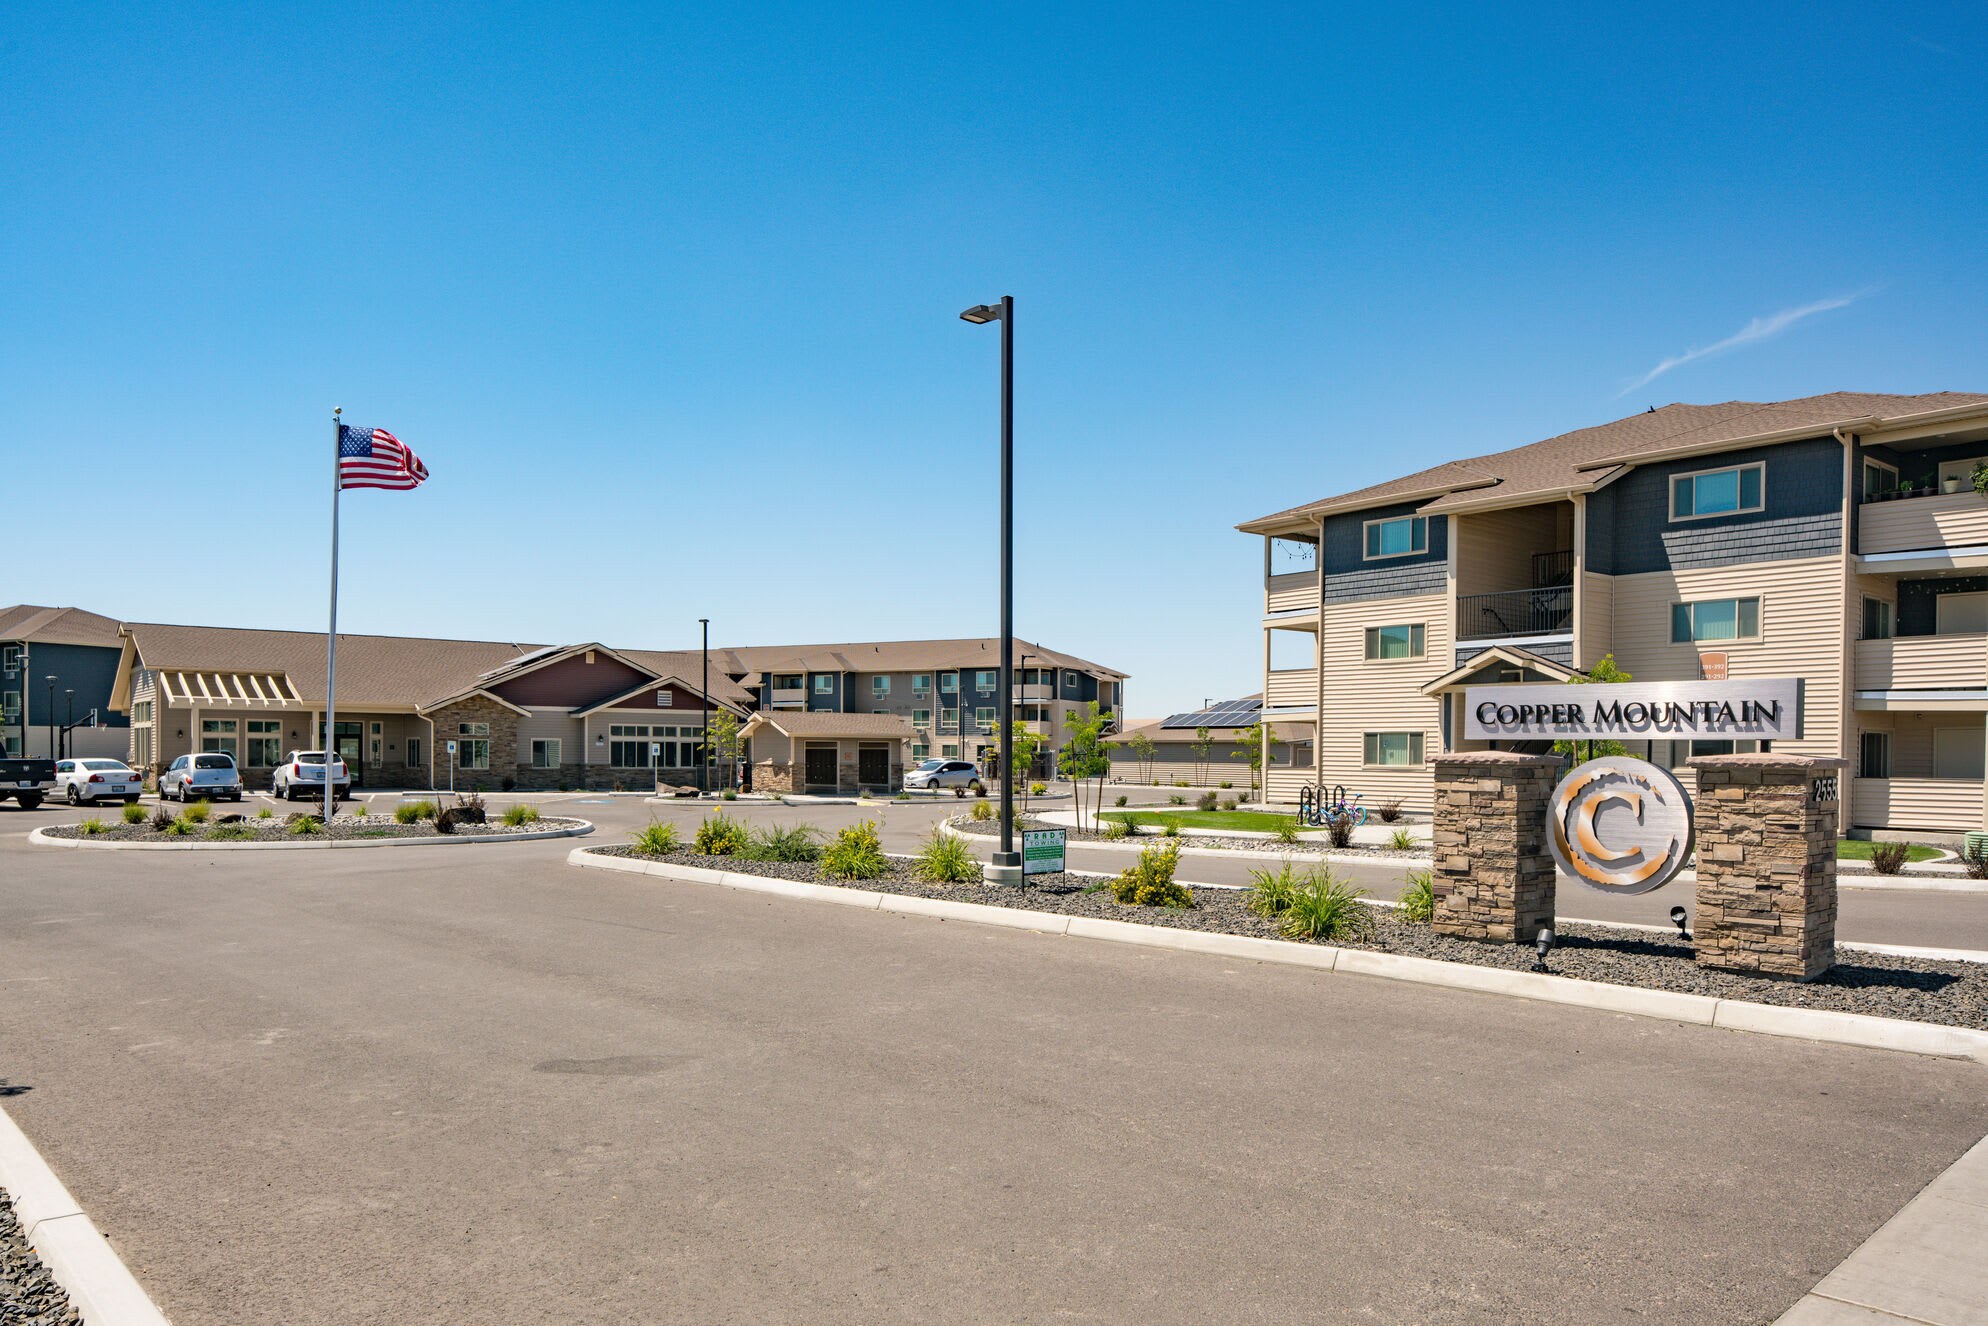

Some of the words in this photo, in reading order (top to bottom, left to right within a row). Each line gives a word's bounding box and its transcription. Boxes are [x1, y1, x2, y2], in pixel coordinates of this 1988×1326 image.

[1476, 701, 1585, 725] COPPER
[1593, 700, 1779, 724] MOUNTAIN
[1815, 779, 1838, 801] 2555
